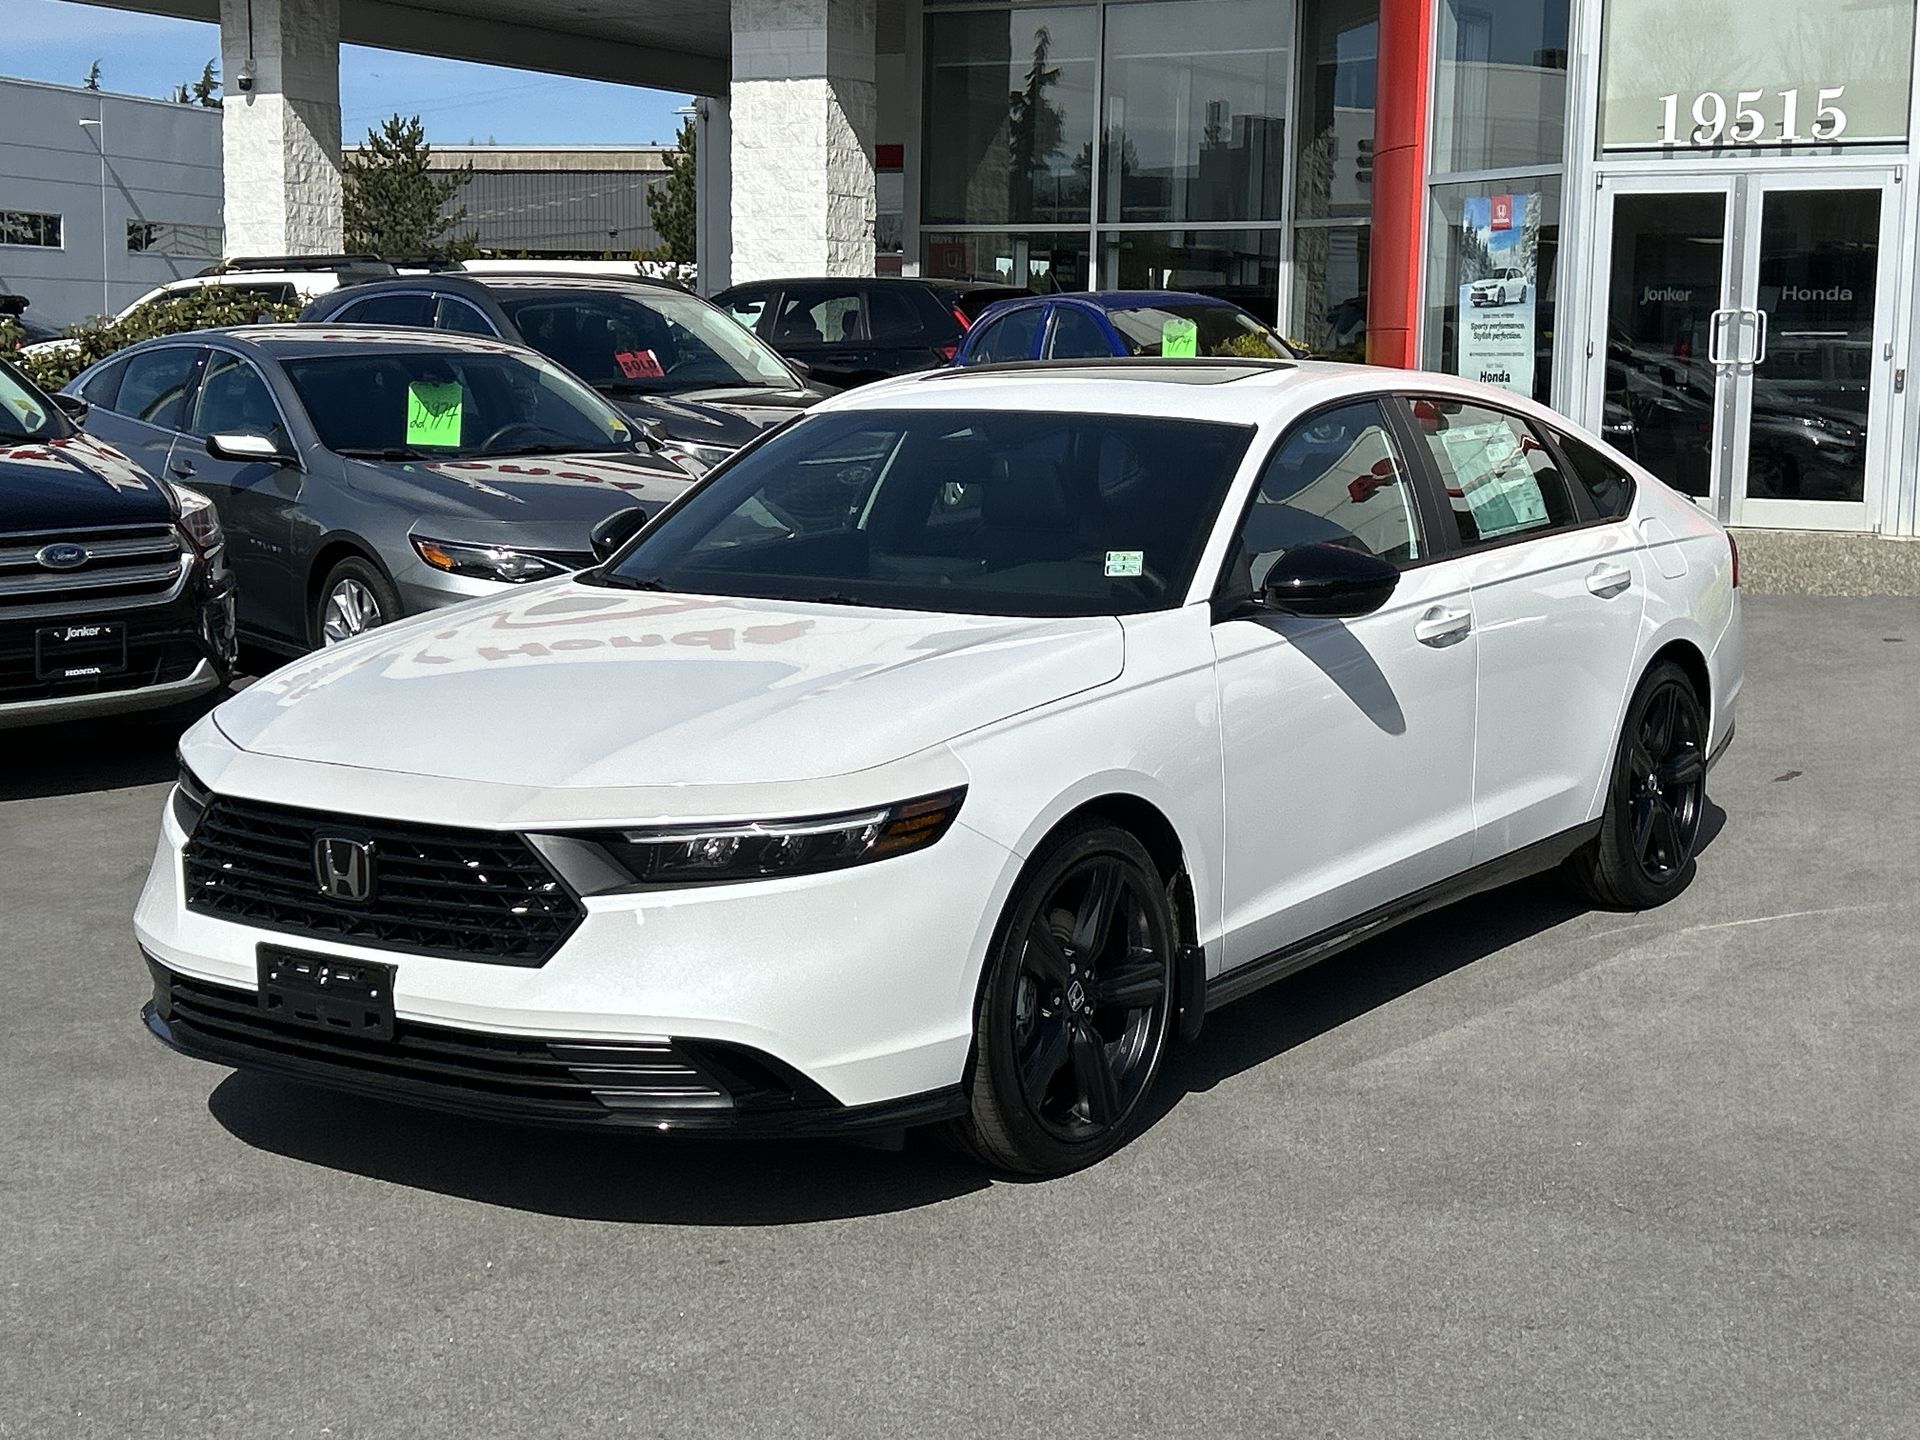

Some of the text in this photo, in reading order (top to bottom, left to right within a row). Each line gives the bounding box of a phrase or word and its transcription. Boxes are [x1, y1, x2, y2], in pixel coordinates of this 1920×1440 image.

[1657, 85, 1848, 144] 19515
[1640, 286, 1693, 305] Jonker
[1782, 286, 1853, 301] Honda
[621, 360, 657, 371] SOLD
[1480, 370, 1511, 383] Honda
[64, 627, 100, 641] Jonker
[64, 667, 101, 676] HONDA
